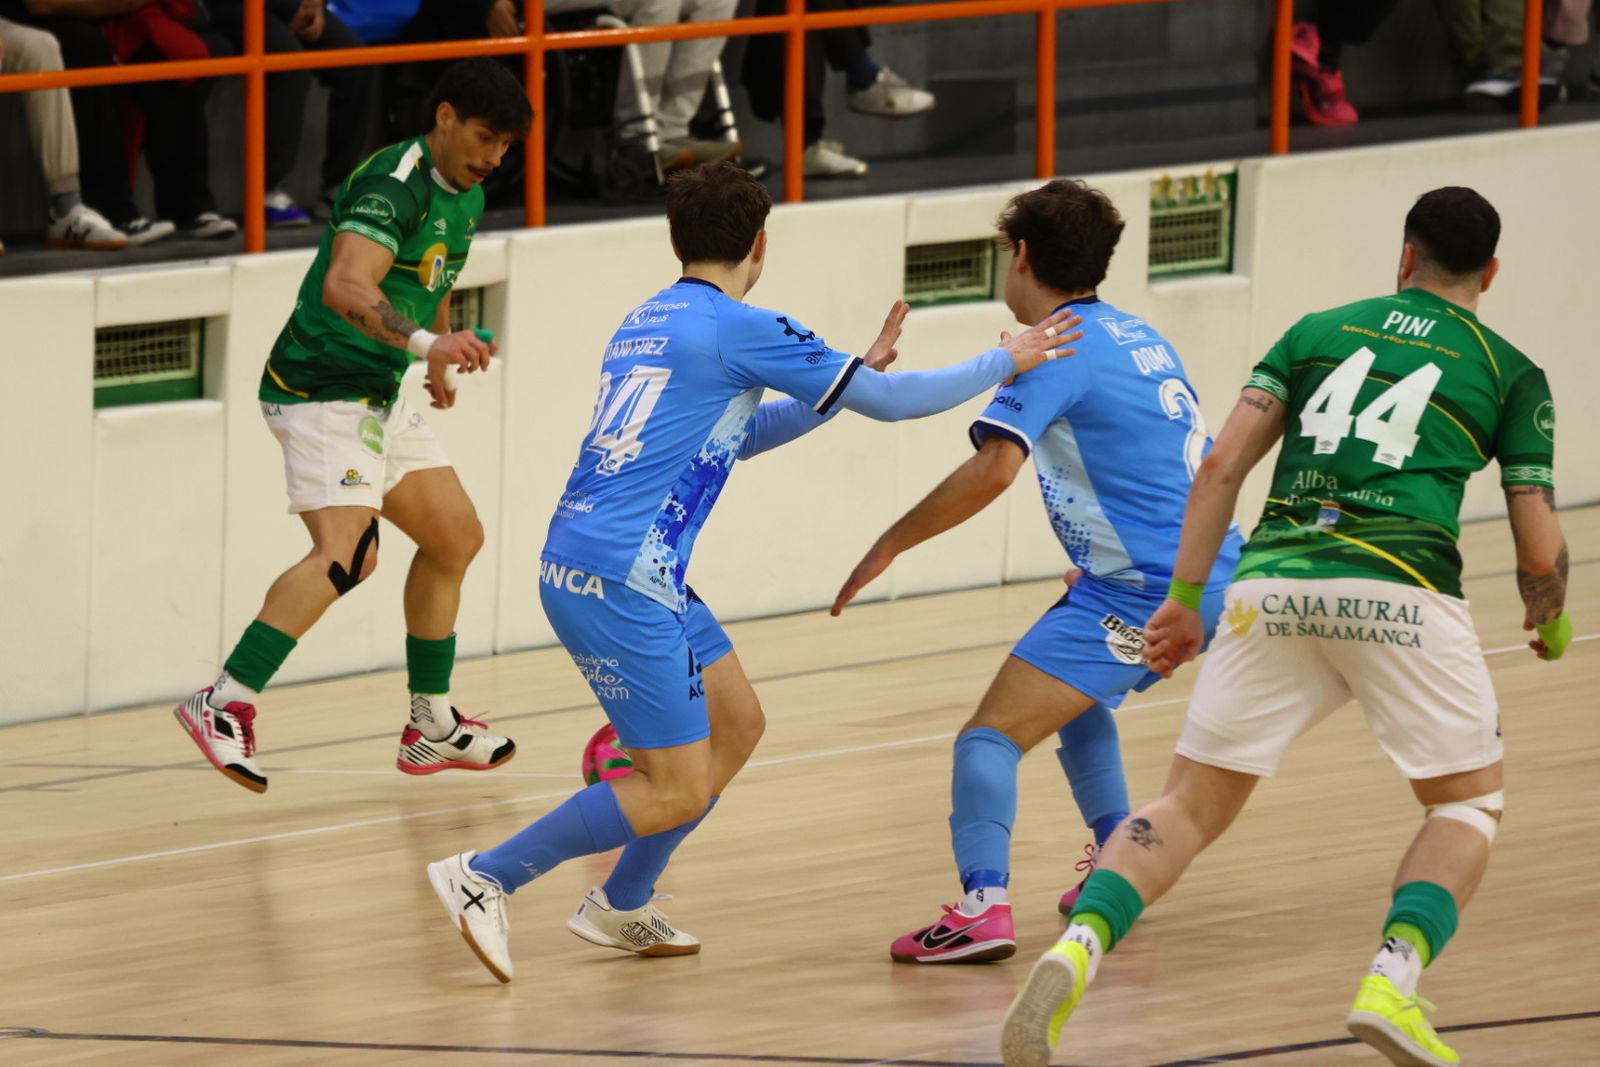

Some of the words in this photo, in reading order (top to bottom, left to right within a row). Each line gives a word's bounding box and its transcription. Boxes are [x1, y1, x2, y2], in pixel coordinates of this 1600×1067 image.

[1382, 310, 1437, 337] PINI
[1299, 345, 1443, 469] 44
[1158, 377, 1208, 484] 2
[1291, 470, 1339, 490] Alba
[1261, 594, 1329, 620] CAJA
[1336, 597, 1425, 626] RURAL
[1265, 622, 1292, 637] DE
[1295, 621, 1422, 648] SALAMANCA
